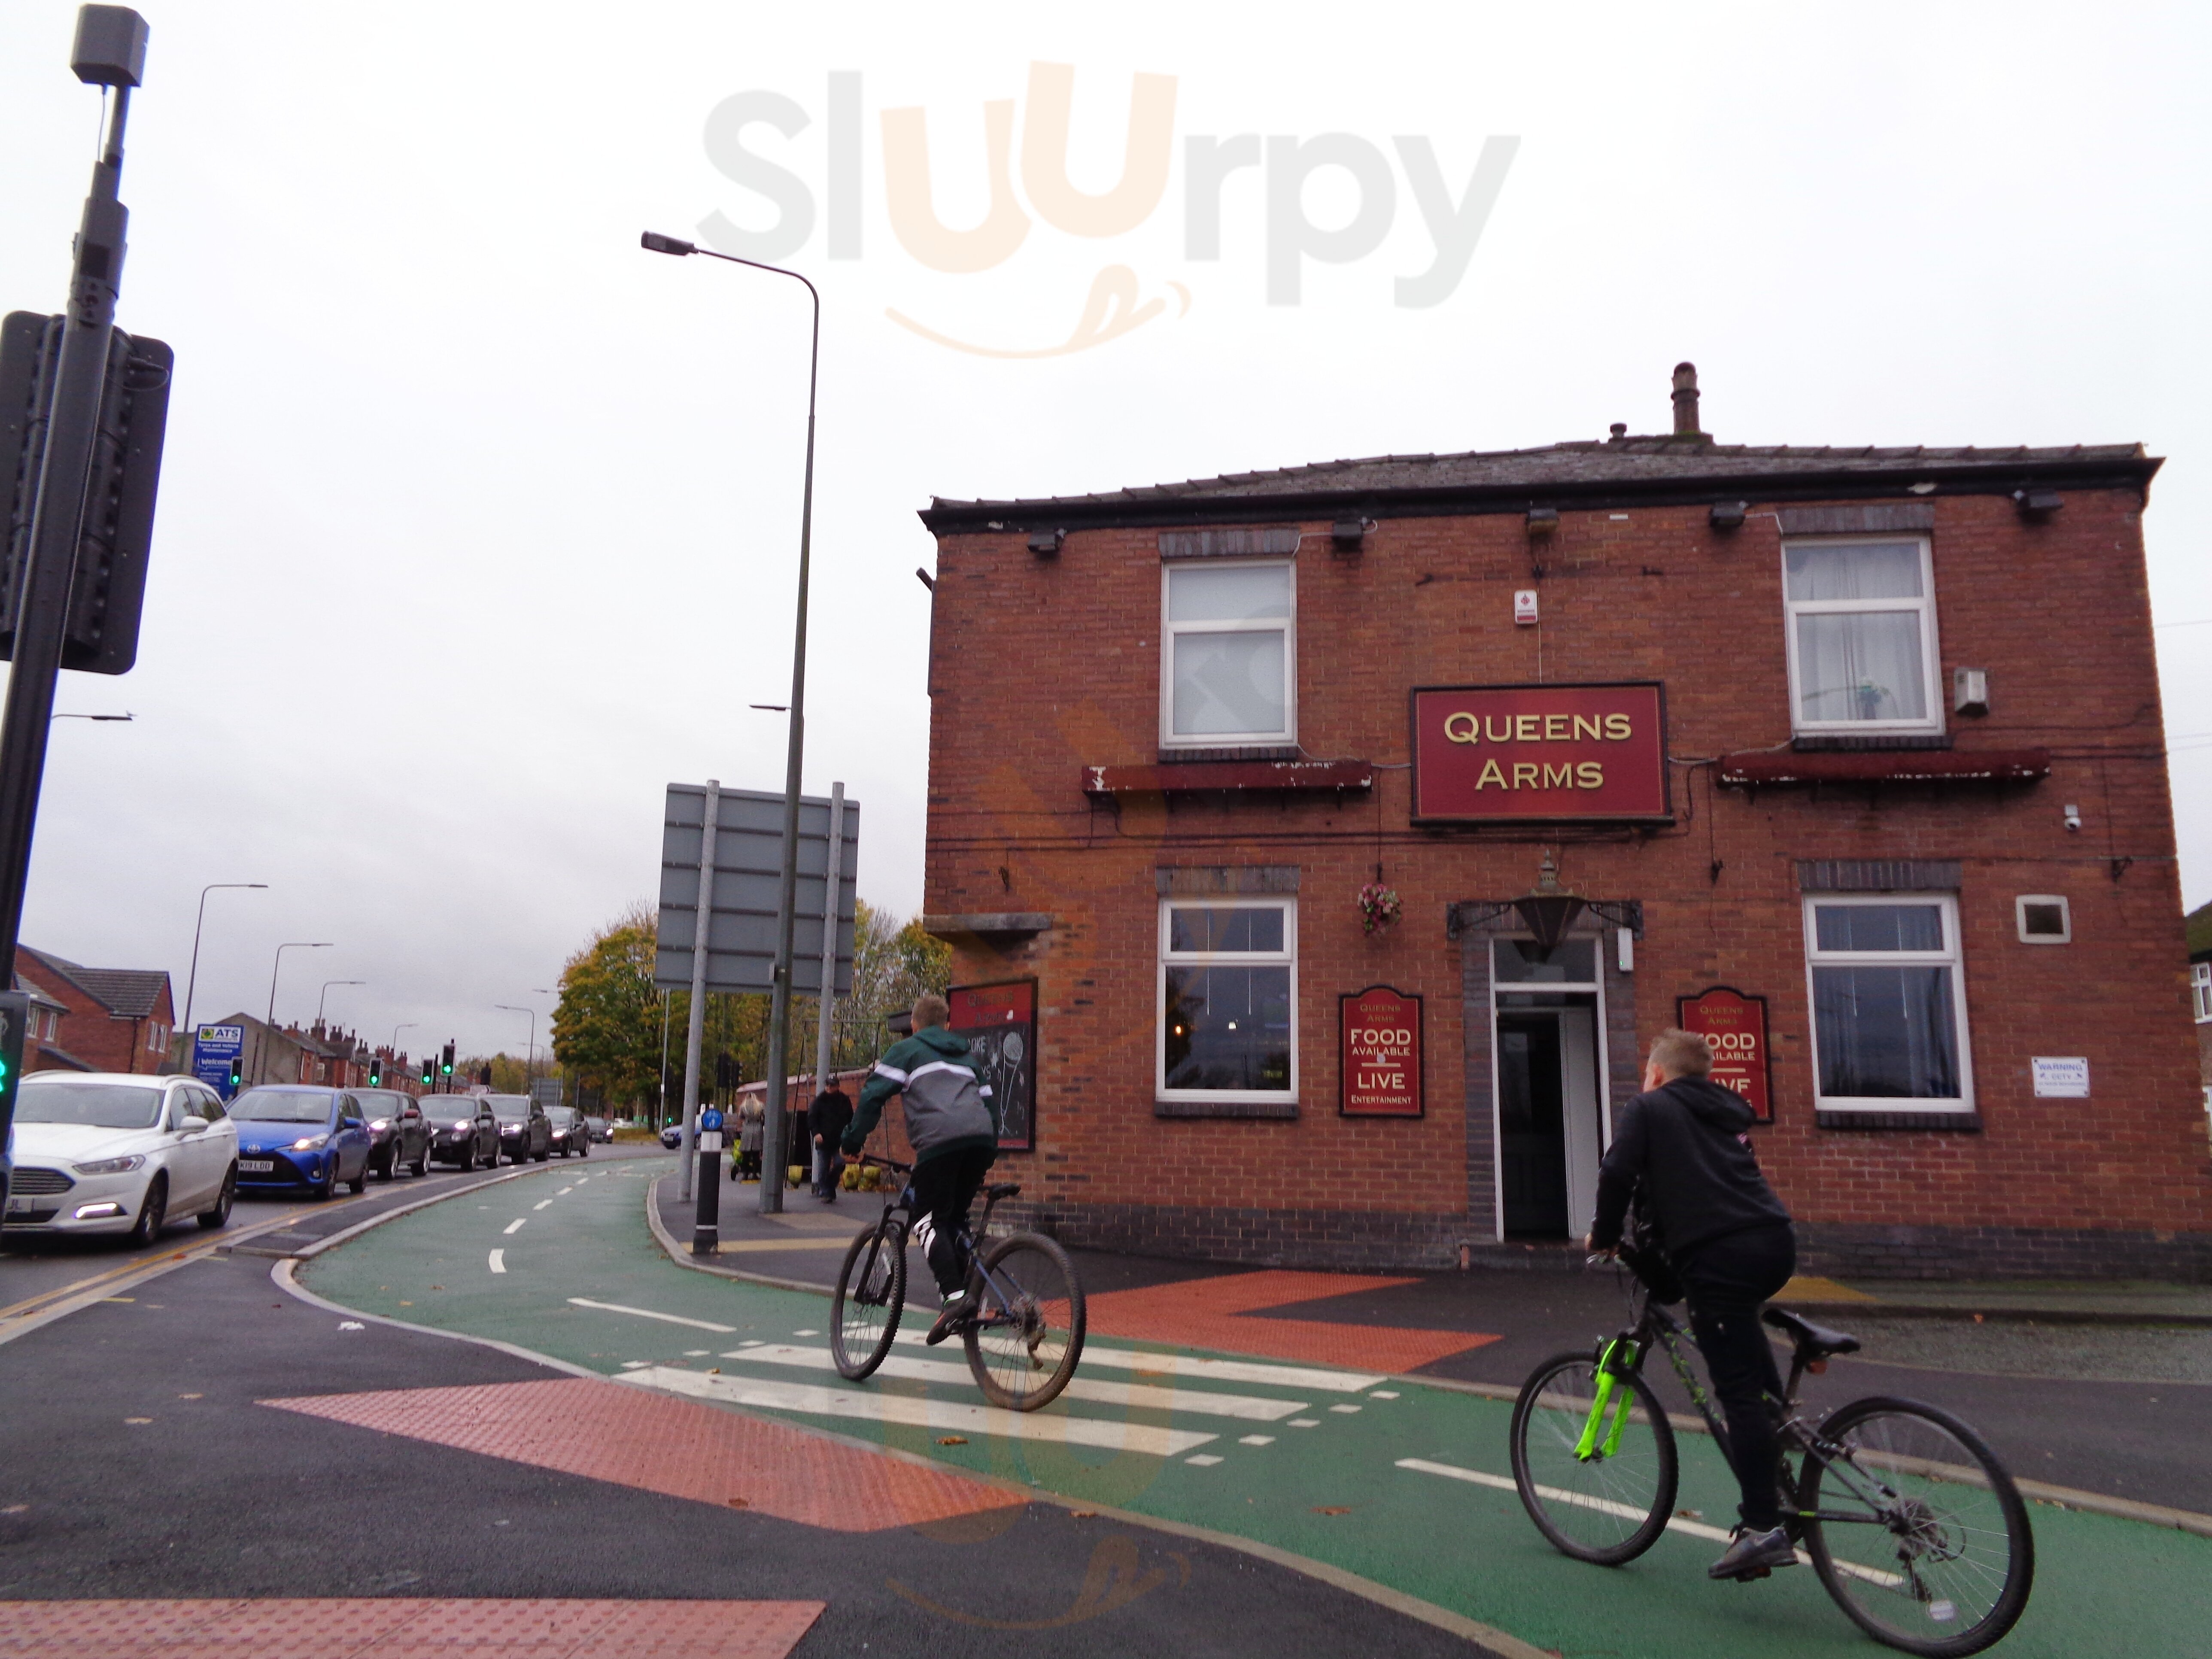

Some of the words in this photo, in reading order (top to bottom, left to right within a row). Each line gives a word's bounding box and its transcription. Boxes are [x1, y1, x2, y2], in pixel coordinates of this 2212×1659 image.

[216, 1029, 239, 1037] ATS
[1351, 1028, 1411, 1045] FOOD
[1352, 1046, 1410, 1056] AVAILABLE
[1358, 1072, 1406, 1090] LIVE
[1351, 1094, 1411, 1105] ENTERTAINMENT
